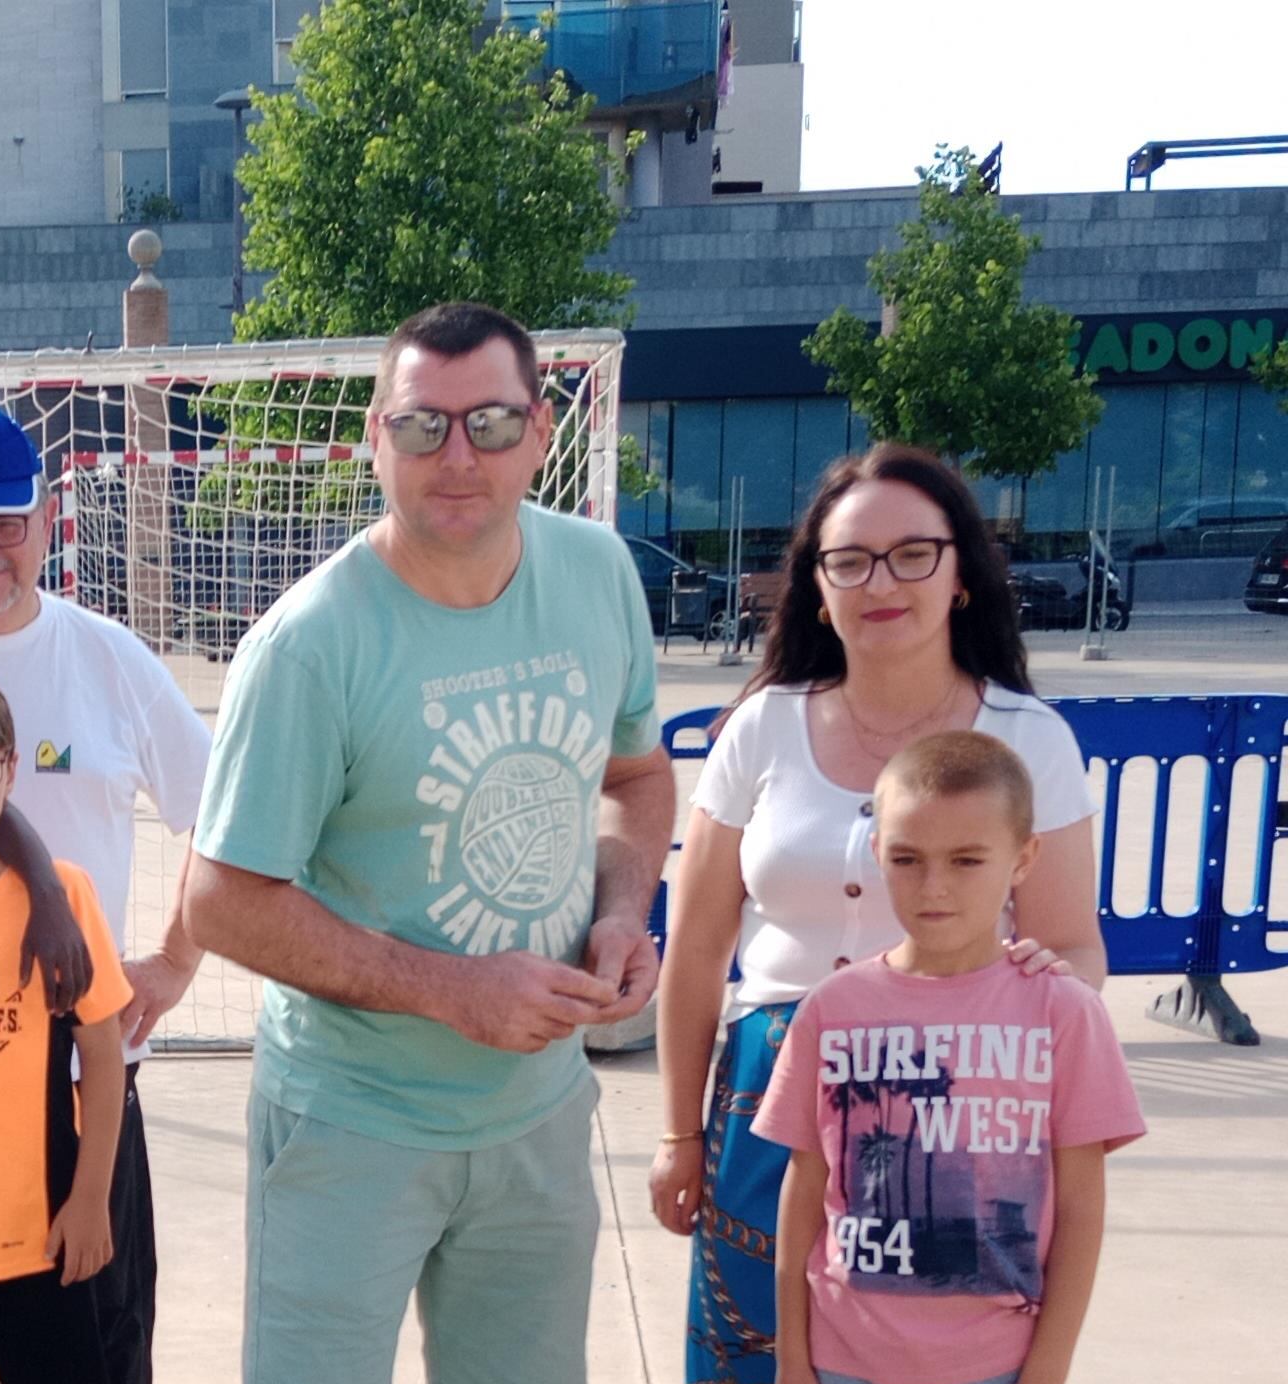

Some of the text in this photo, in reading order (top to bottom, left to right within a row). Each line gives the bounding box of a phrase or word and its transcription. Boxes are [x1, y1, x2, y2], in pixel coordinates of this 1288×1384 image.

[1069, 316, 1288, 373] ADON
[528, 649, 580, 679] ROLL
[425, 882, 519, 957] LAKE
[818, 1023, 1053, 1085] SURFING
[911, 1096, 1051, 1156] WEST
